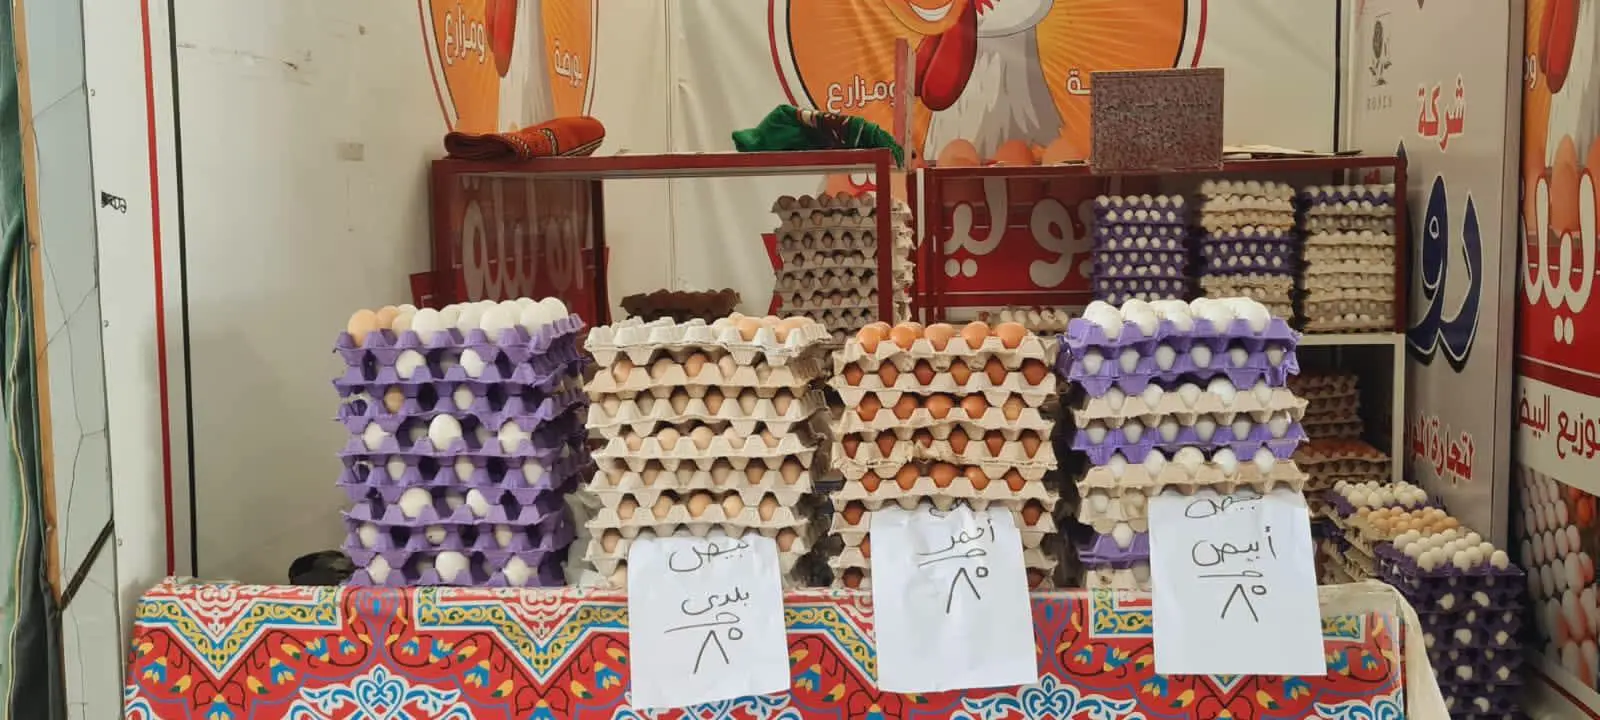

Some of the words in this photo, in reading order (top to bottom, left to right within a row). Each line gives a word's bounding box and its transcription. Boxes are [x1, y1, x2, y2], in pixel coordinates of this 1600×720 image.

[444, 5, 487, 65] ومزارع
[1417, 76, 1465, 151] شركة
[1408, 174, 1483, 362] رو
[1557, 411, 1600, 459] وزيع
